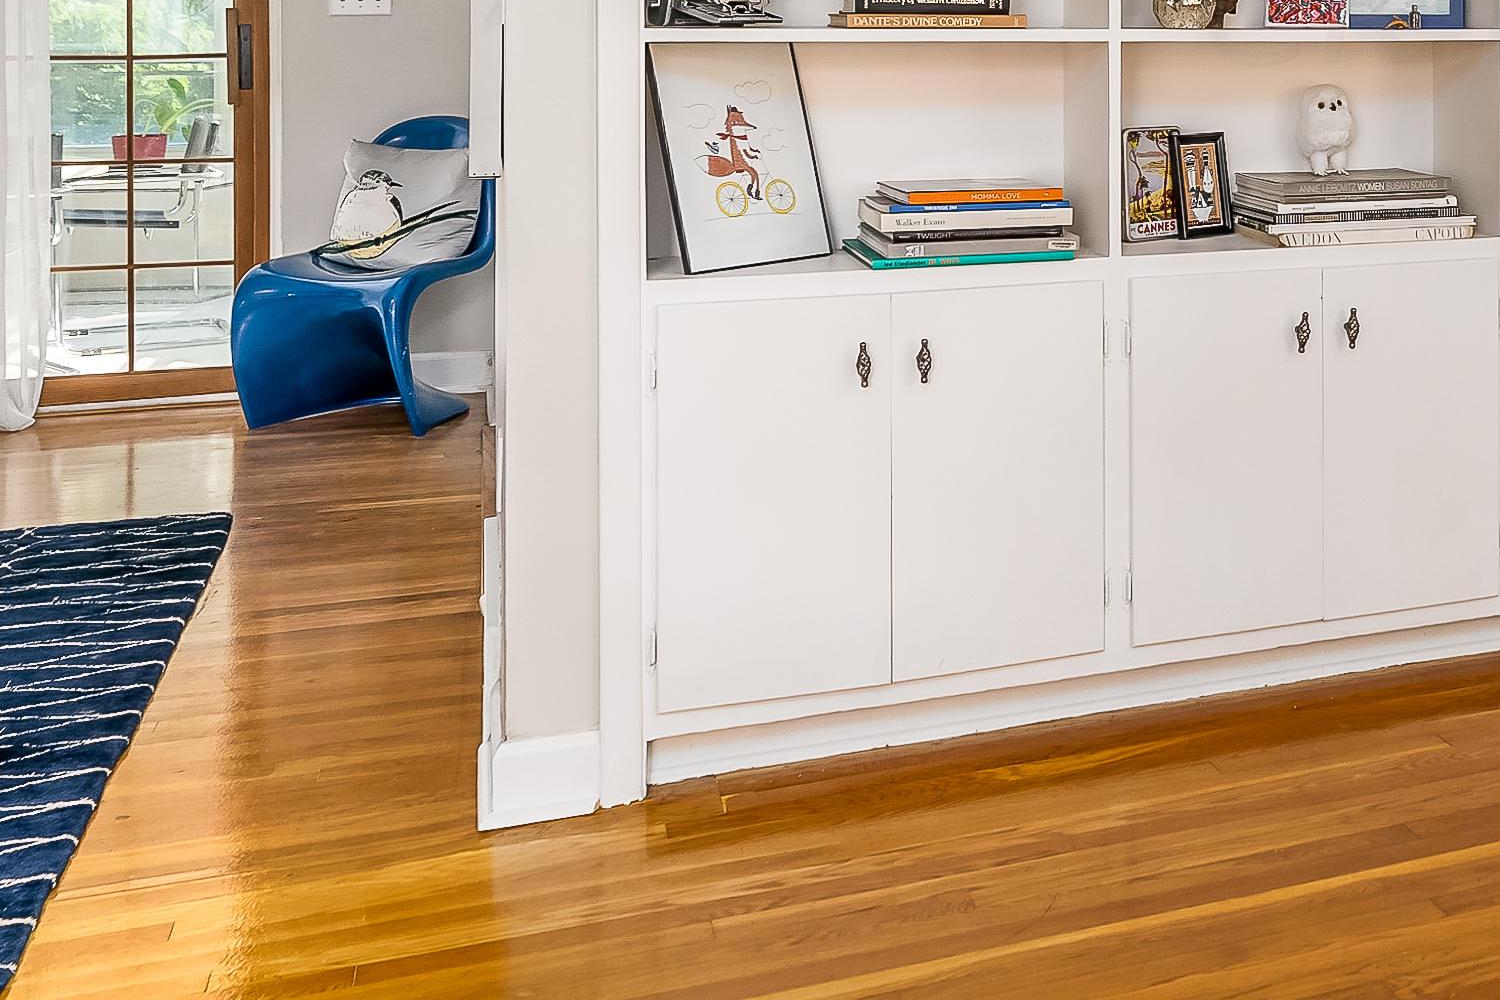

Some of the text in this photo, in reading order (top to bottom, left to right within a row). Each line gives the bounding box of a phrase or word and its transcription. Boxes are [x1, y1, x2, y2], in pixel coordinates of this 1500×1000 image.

[853, 16, 983, 27] DANTE'S DIVINE COMEDY
[1357, 181, 1385, 192] WOMEN
[970, 193, 1000, 201] MOMMA
[895, 217, 946, 227] Walker Evans
[1136, 220, 1177, 235] CANNES
